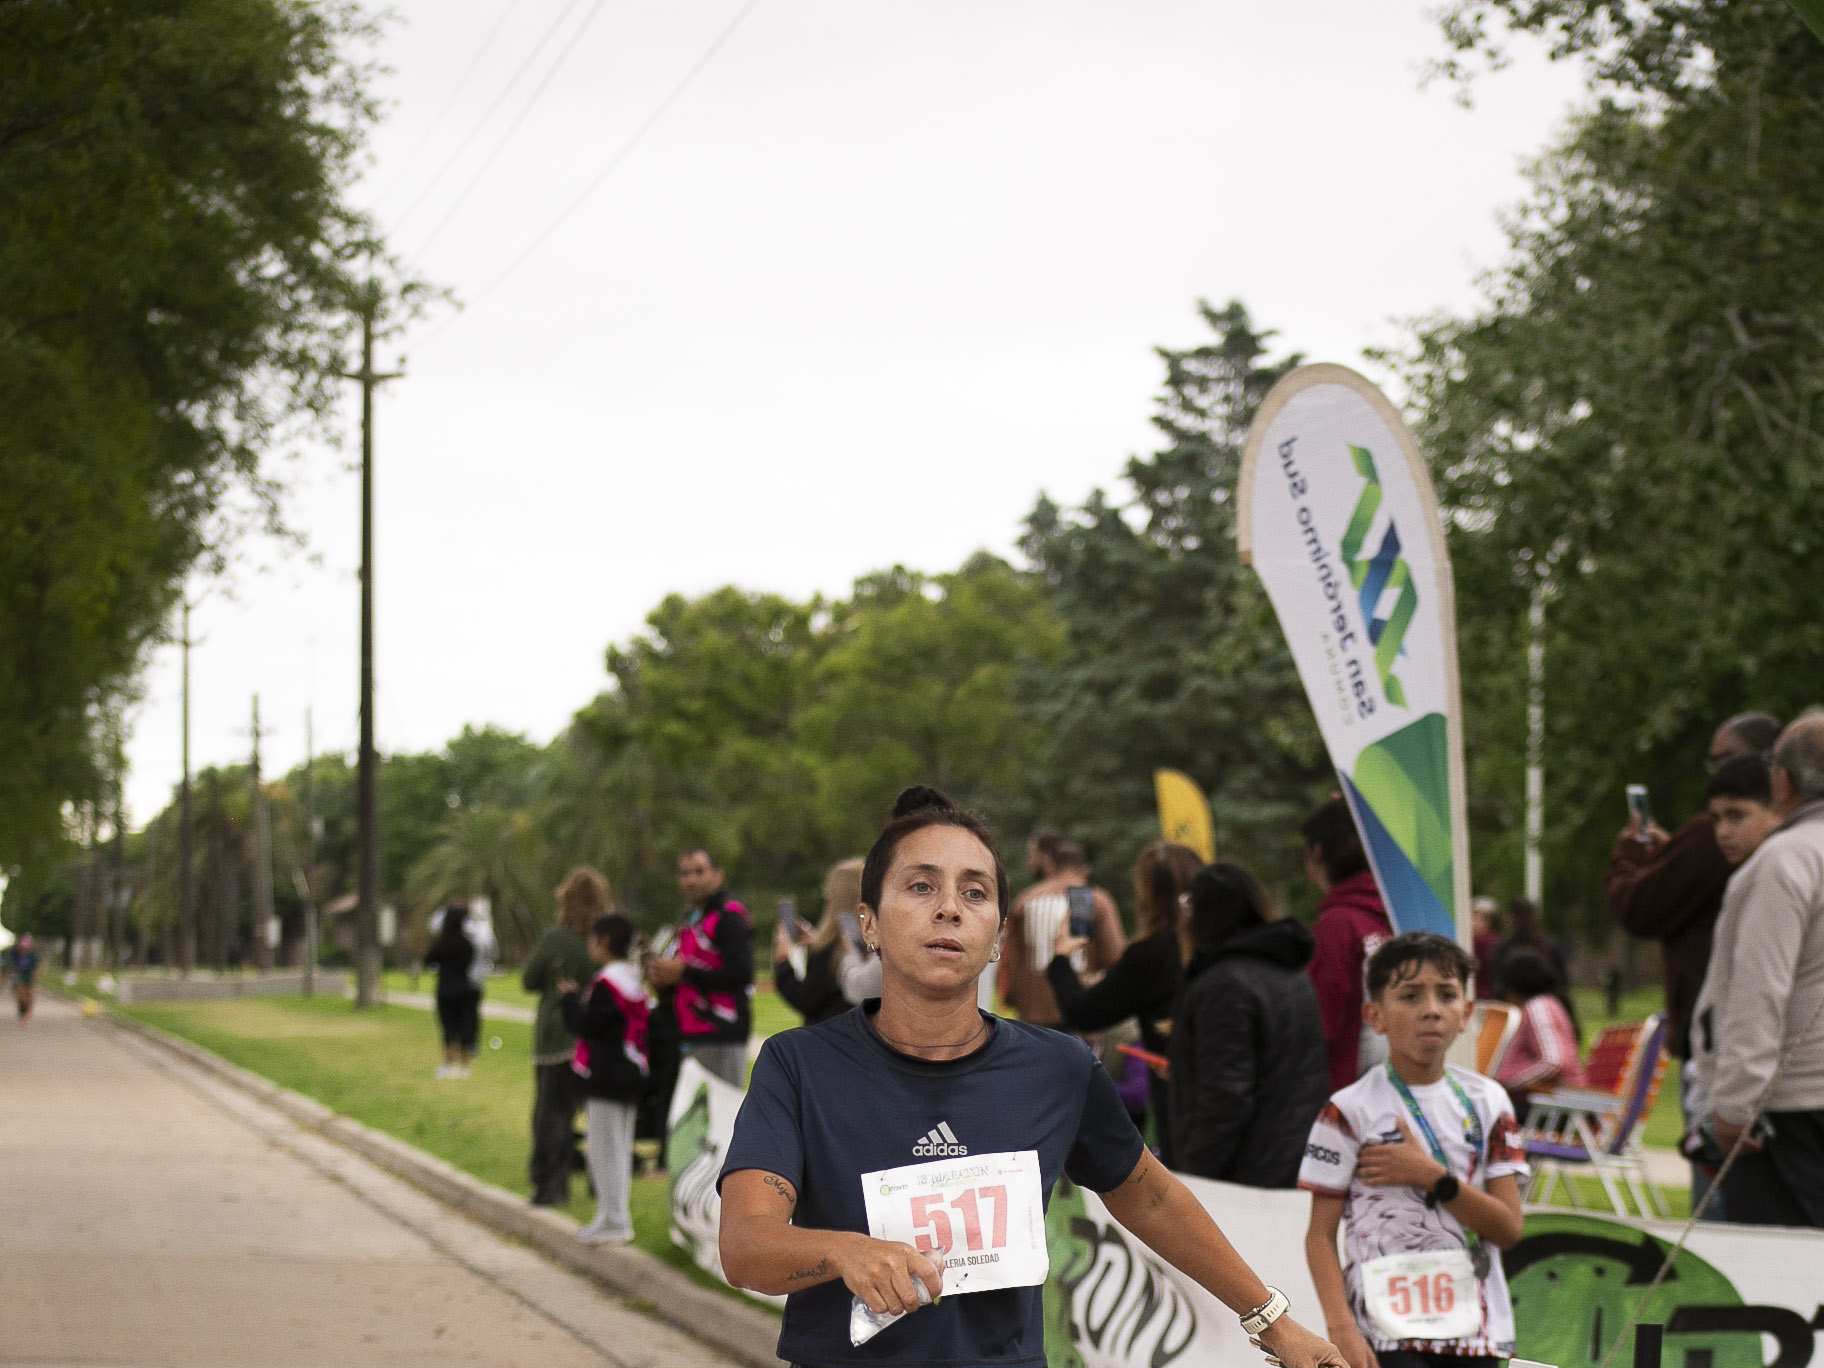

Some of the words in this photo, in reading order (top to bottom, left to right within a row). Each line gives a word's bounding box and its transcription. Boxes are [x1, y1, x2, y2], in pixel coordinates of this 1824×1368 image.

[912, 1143, 968, 1157] adidas
[910, 1185, 1008, 1256] 517
[945, 1257, 966, 1269] LERIA
[967, 1253, 1000, 1266] SOLEDAD
[1388, 1272, 1455, 1316] 516
